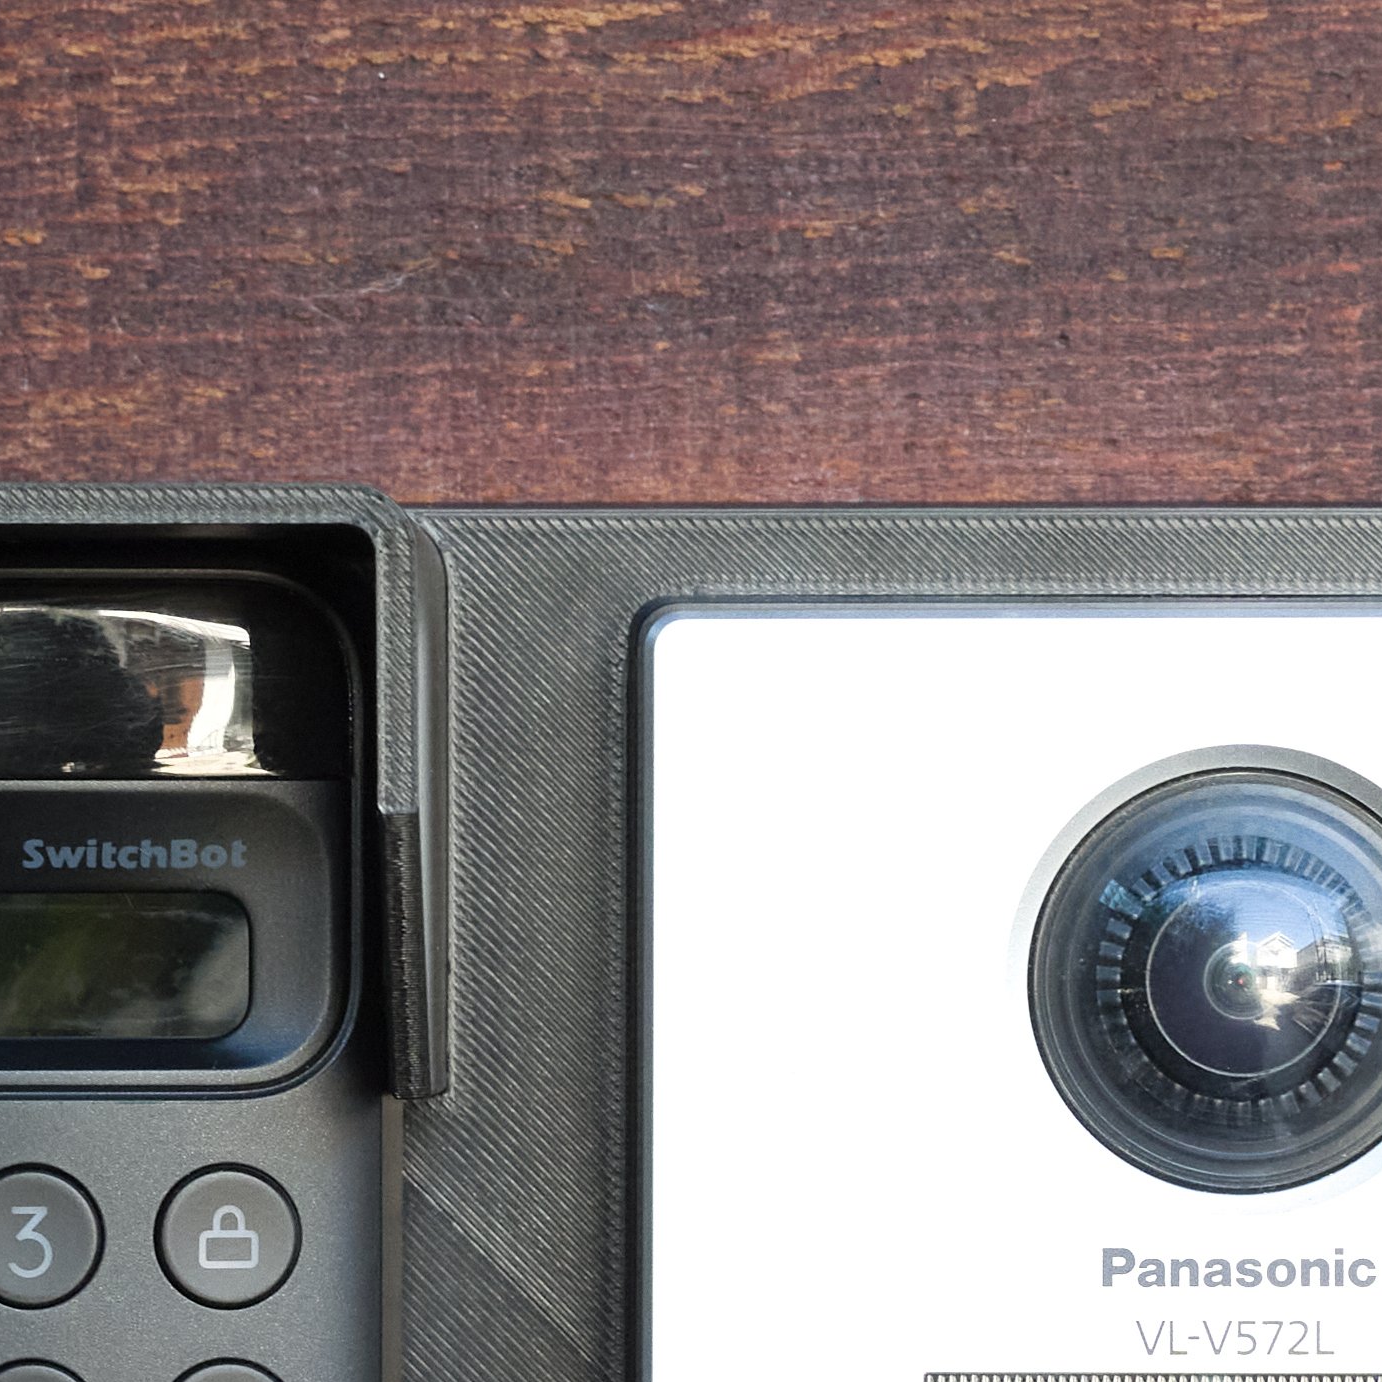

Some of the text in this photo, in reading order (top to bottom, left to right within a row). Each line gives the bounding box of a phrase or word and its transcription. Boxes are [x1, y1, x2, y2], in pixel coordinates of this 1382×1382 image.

[21, 837, 248, 871] SwitchBot
[7, 1205, 54, 1279] 3
[1101, 1247, 1377, 1288] Panasonic
[1135, 1320, 1335, 1356] VL-V572L
